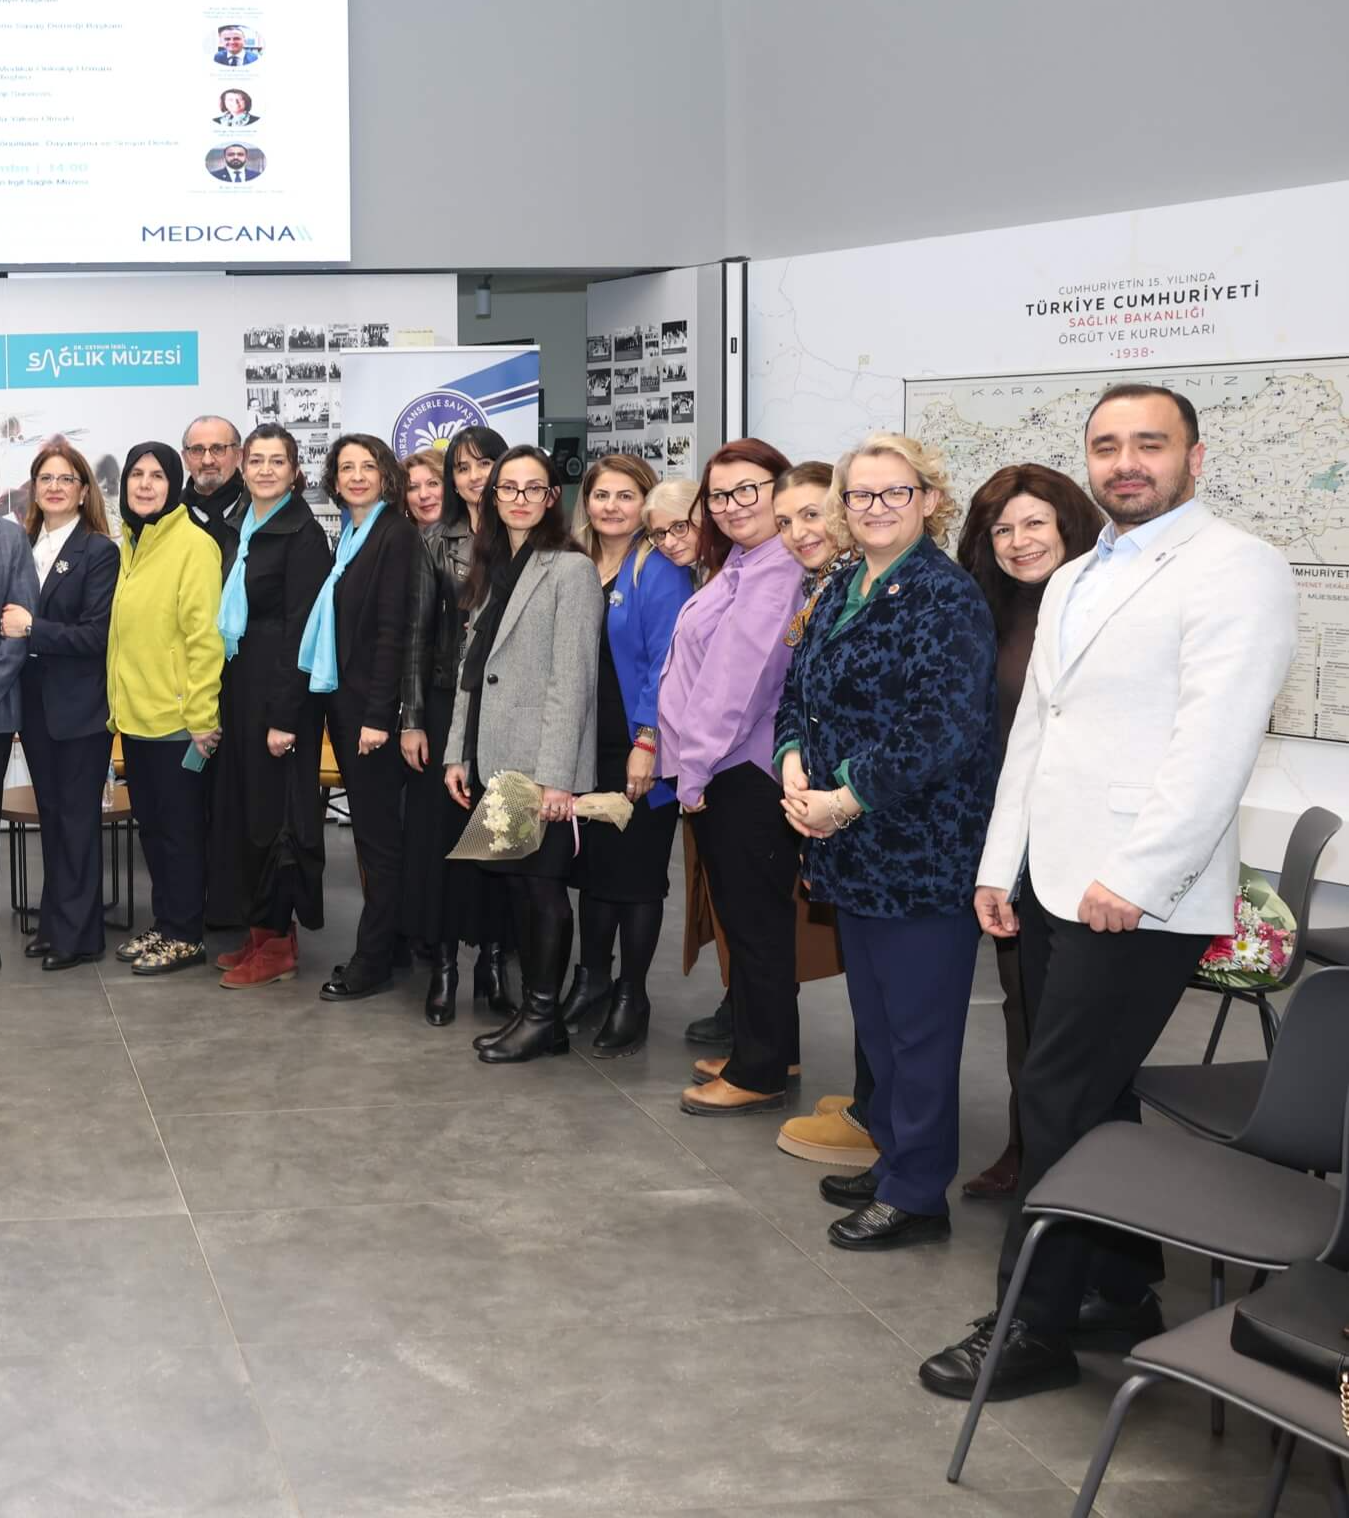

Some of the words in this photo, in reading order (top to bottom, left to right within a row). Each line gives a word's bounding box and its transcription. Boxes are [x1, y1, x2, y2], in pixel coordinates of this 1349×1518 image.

[142, 225, 296, 242] MEDICANA
[1058, 278, 1144, 295] CUMHURİYETİN
[1148, 278, 1163, 287] 15.
[1167, 272, 1216, 285] YILINDA
[1026, 296, 1106, 317] TÜRKİYE
[1113, 280, 1260, 309] CUMHURİYETİ
[1068, 312, 1118, 328] SAĞLIK
[1124, 306, 1206, 325] BAKANLIĞI
[1058, 330, 1105, 345] ÖRGÜT
[1109, 330, 1125, 341] VE
[1130, 324, 1216, 341] KURUMLARI
[26, 346, 105, 378] SAĞLIK
[112, 345, 181, 365] MÜZESİ
[402, 399, 442, 429] KANSERLE
[399, 432, 409, 456] URSA
